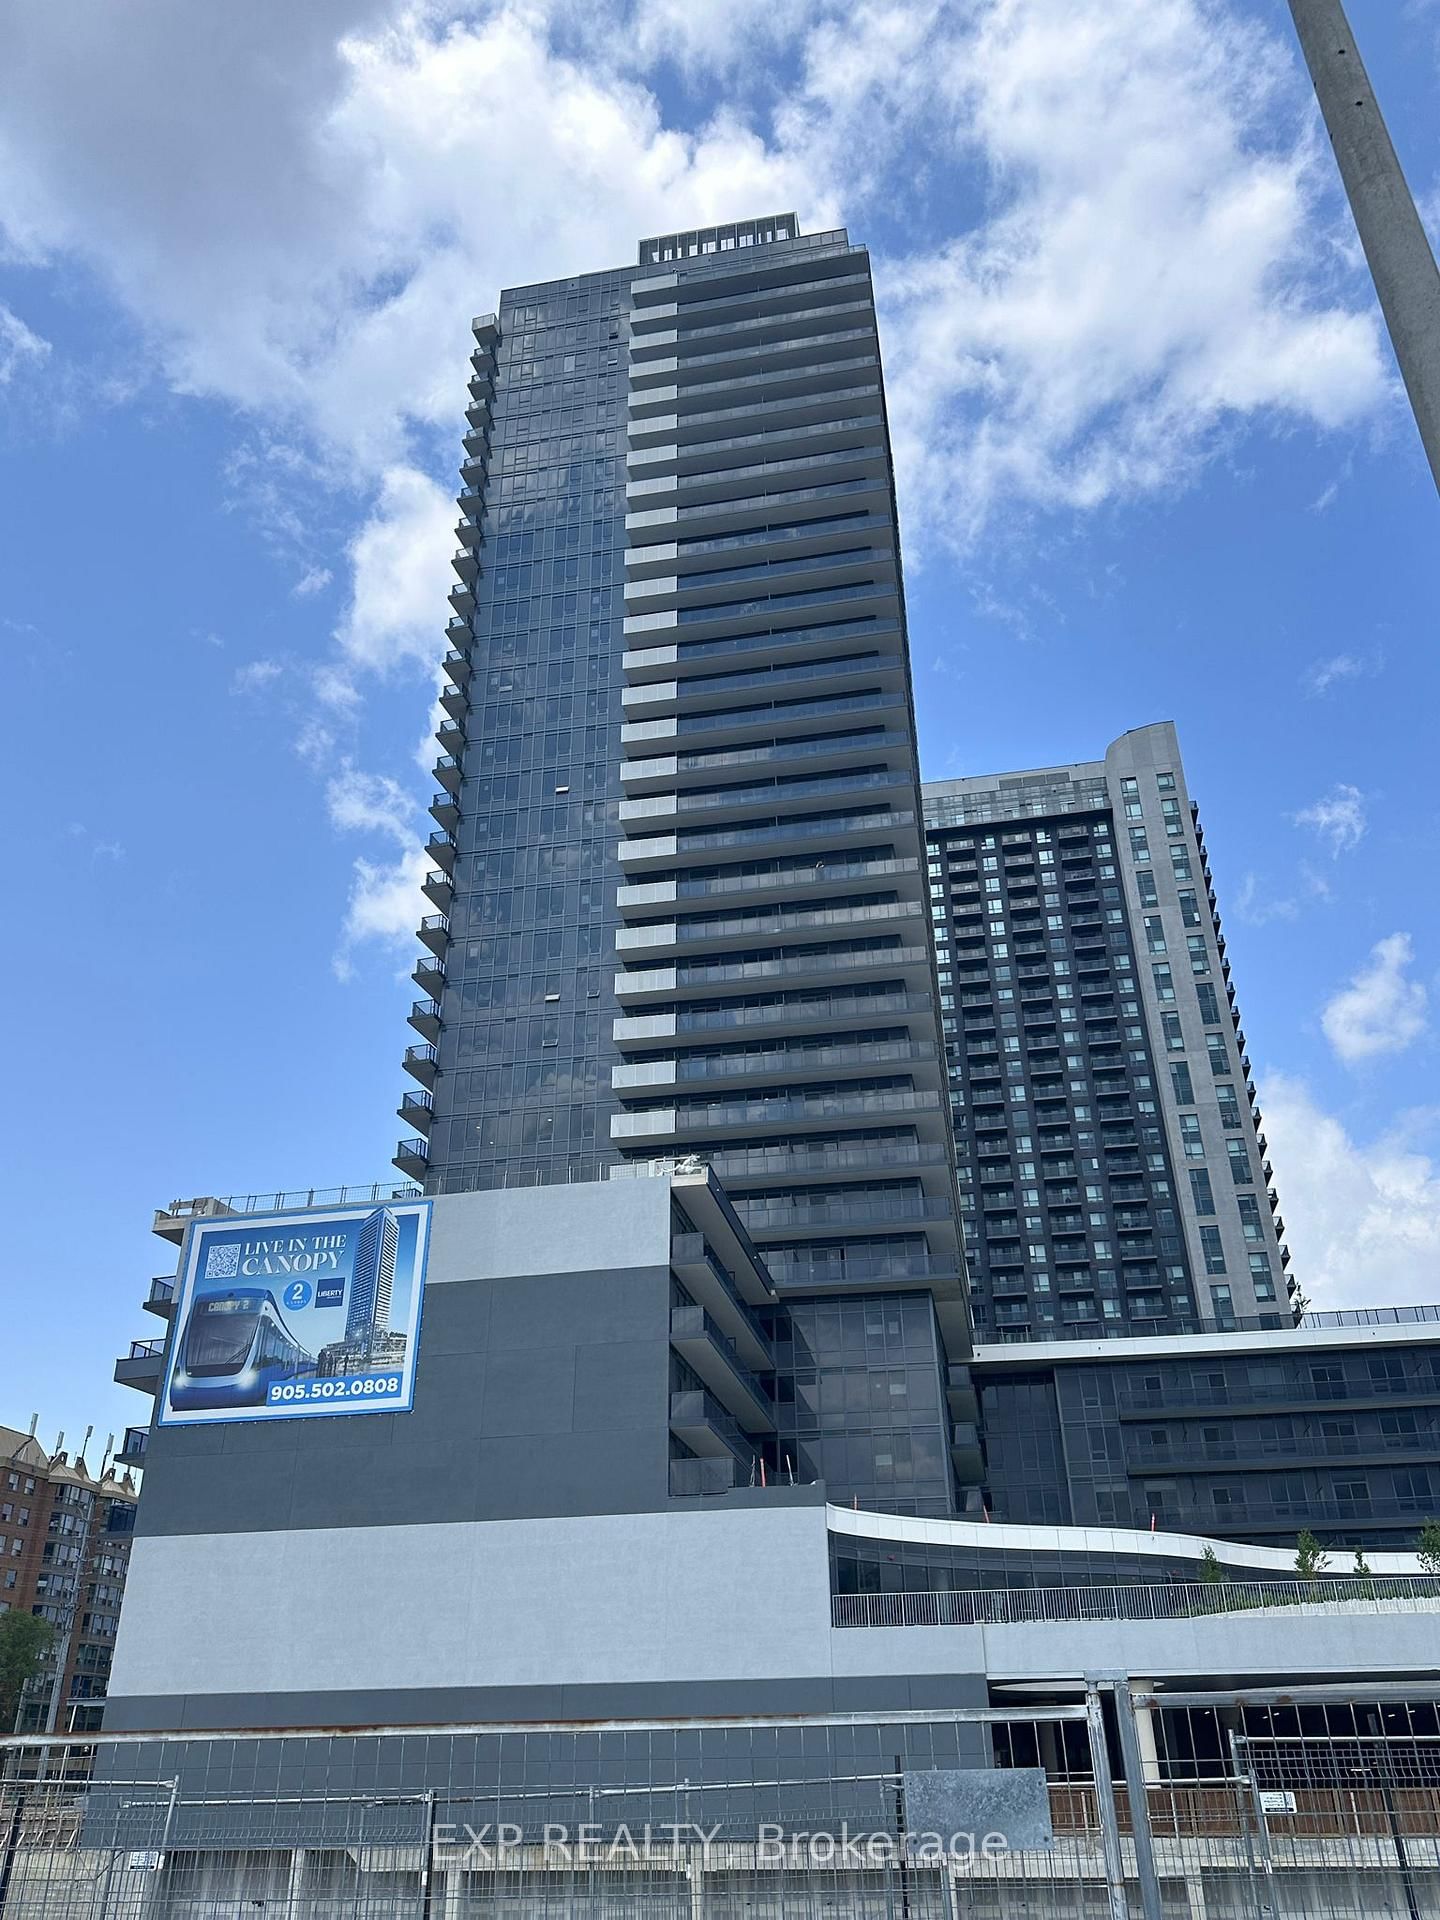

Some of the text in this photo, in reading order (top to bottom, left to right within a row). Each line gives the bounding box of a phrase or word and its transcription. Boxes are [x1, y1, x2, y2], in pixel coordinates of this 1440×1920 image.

[245, 1235, 347, 1256] LIVE IN THE
[241, 1250, 345, 1276] CANOPY
[291, 1283, 304, 1300] 2
[317, 1289, 343, 1298] LIBERTY
[242, 1300, 249, 1310] 2
[271, 1377, 399, 1401] 905.502.0808
